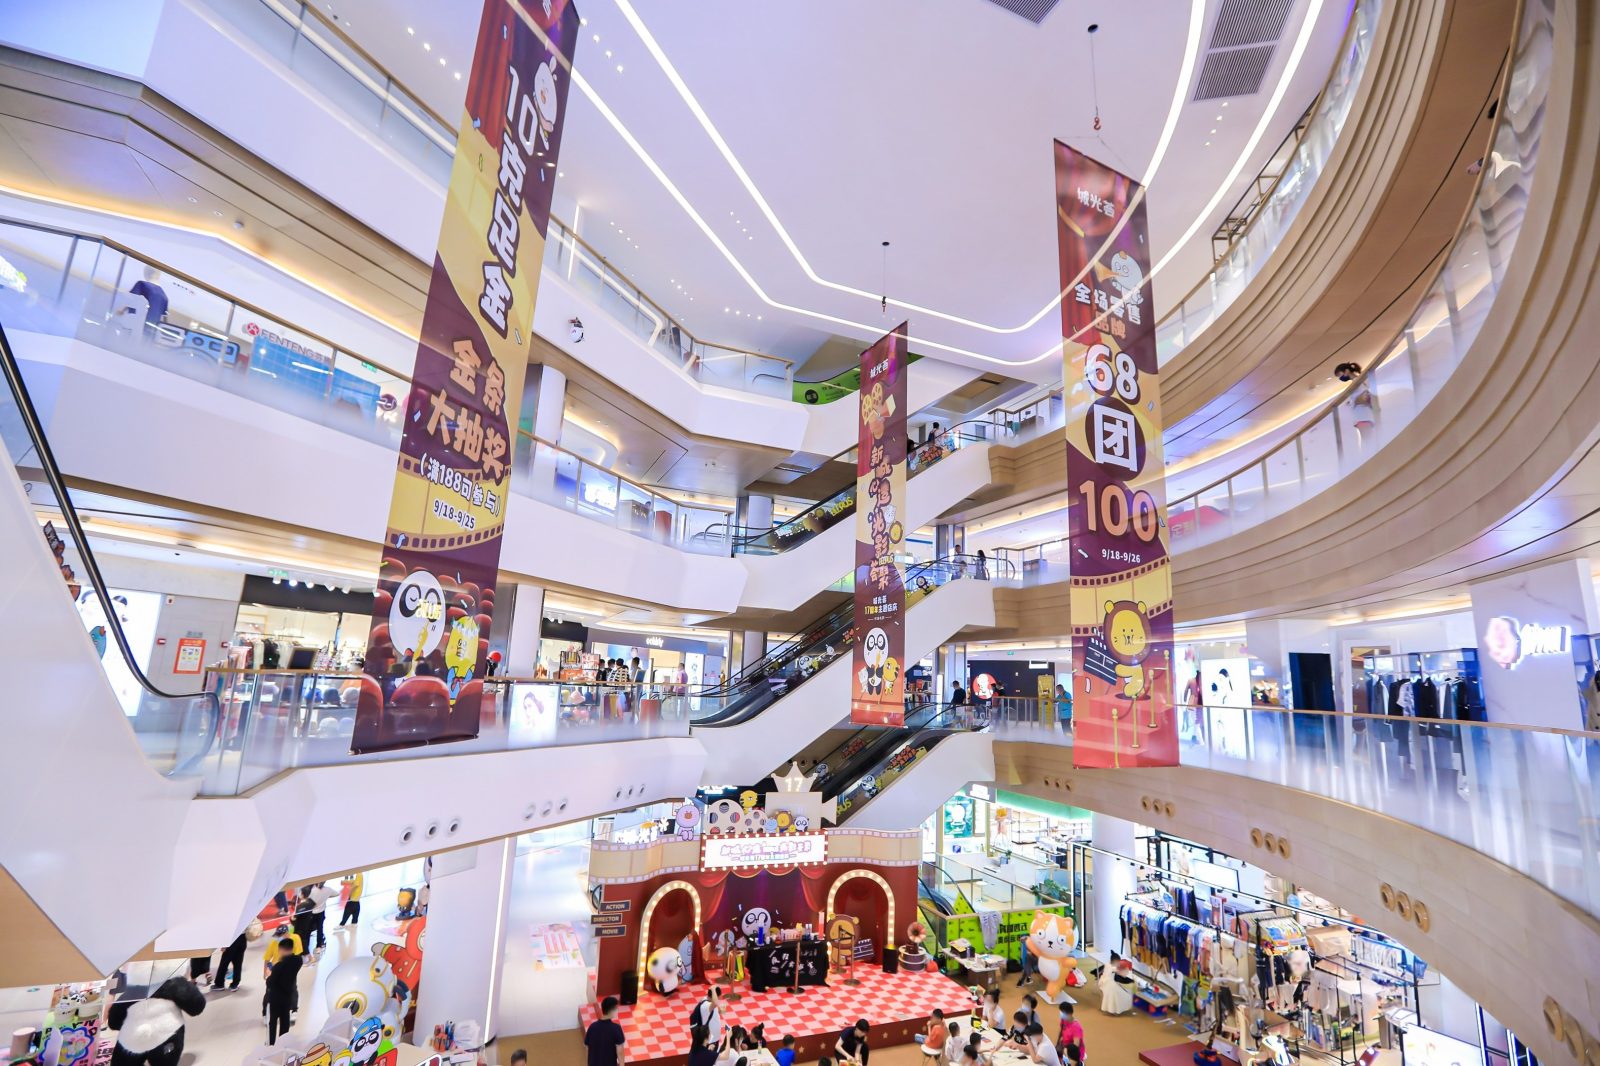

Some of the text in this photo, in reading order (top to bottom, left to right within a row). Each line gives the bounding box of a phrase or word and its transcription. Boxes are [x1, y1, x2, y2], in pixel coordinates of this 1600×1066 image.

[1076, 187, 1116, 219] 城光荟
[1073, 283, 1142, 326] 全场零售
[449, 339, 505, 416] 金条
[1086, 344, 1139, 401] 68
[426, 389, 507, 479] 大抽奖
[1093, 403, 1139, 472] 团
[433, 499, 475, 529] 9/18-9/25
[1079, 480, 1157, 543] 100
[1101, 548, 1141, 564] 9/18-9/26
[785, 777, 804, 793] 17
[592, 916, 620, 924] DIRECTOR
[605, 903, 626, 911] ACTION
[601, 928, 619, 936] MOVIE
